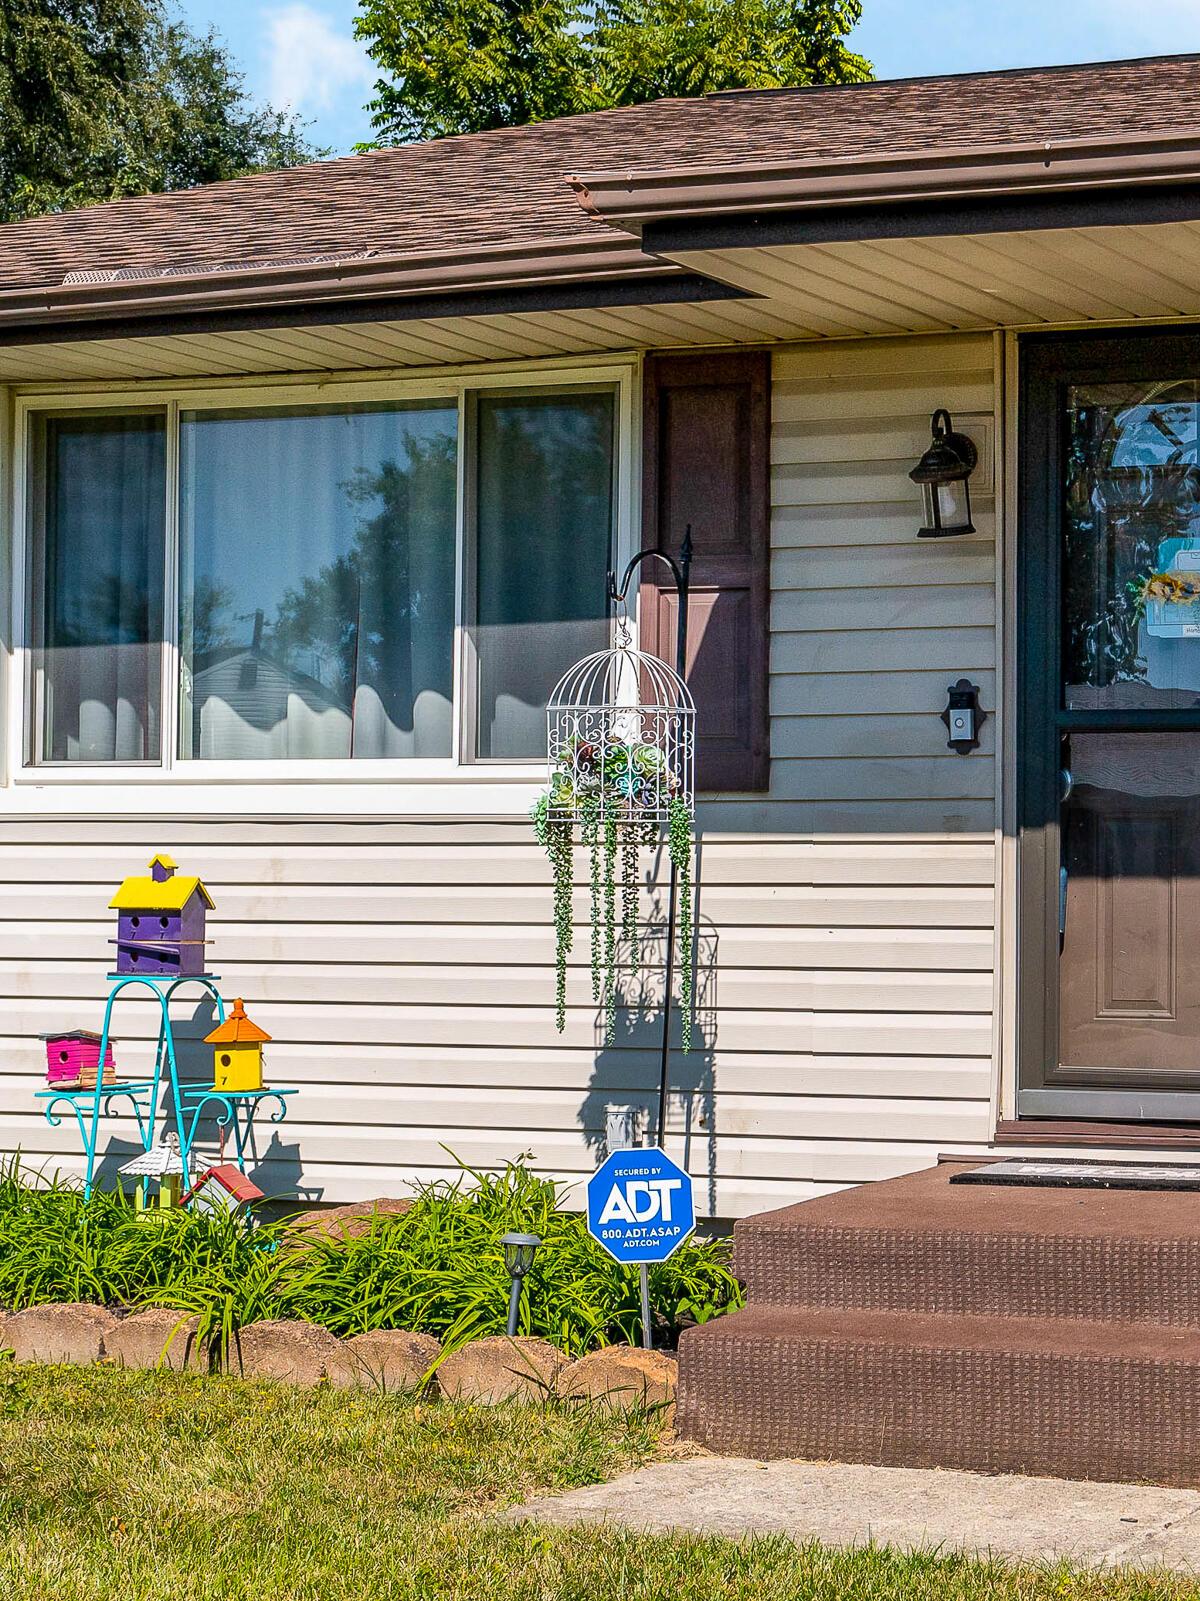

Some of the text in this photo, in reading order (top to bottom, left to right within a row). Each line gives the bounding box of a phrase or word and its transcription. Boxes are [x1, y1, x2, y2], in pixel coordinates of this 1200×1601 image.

[614, 1167, 661, 1176] SECURED BY
[598, 1179, 682, 1225] ADT
[602, 1226, 680, 1239] 800.ADT.ASAP
[623, 1239, 660, 1248] ADT.COM
